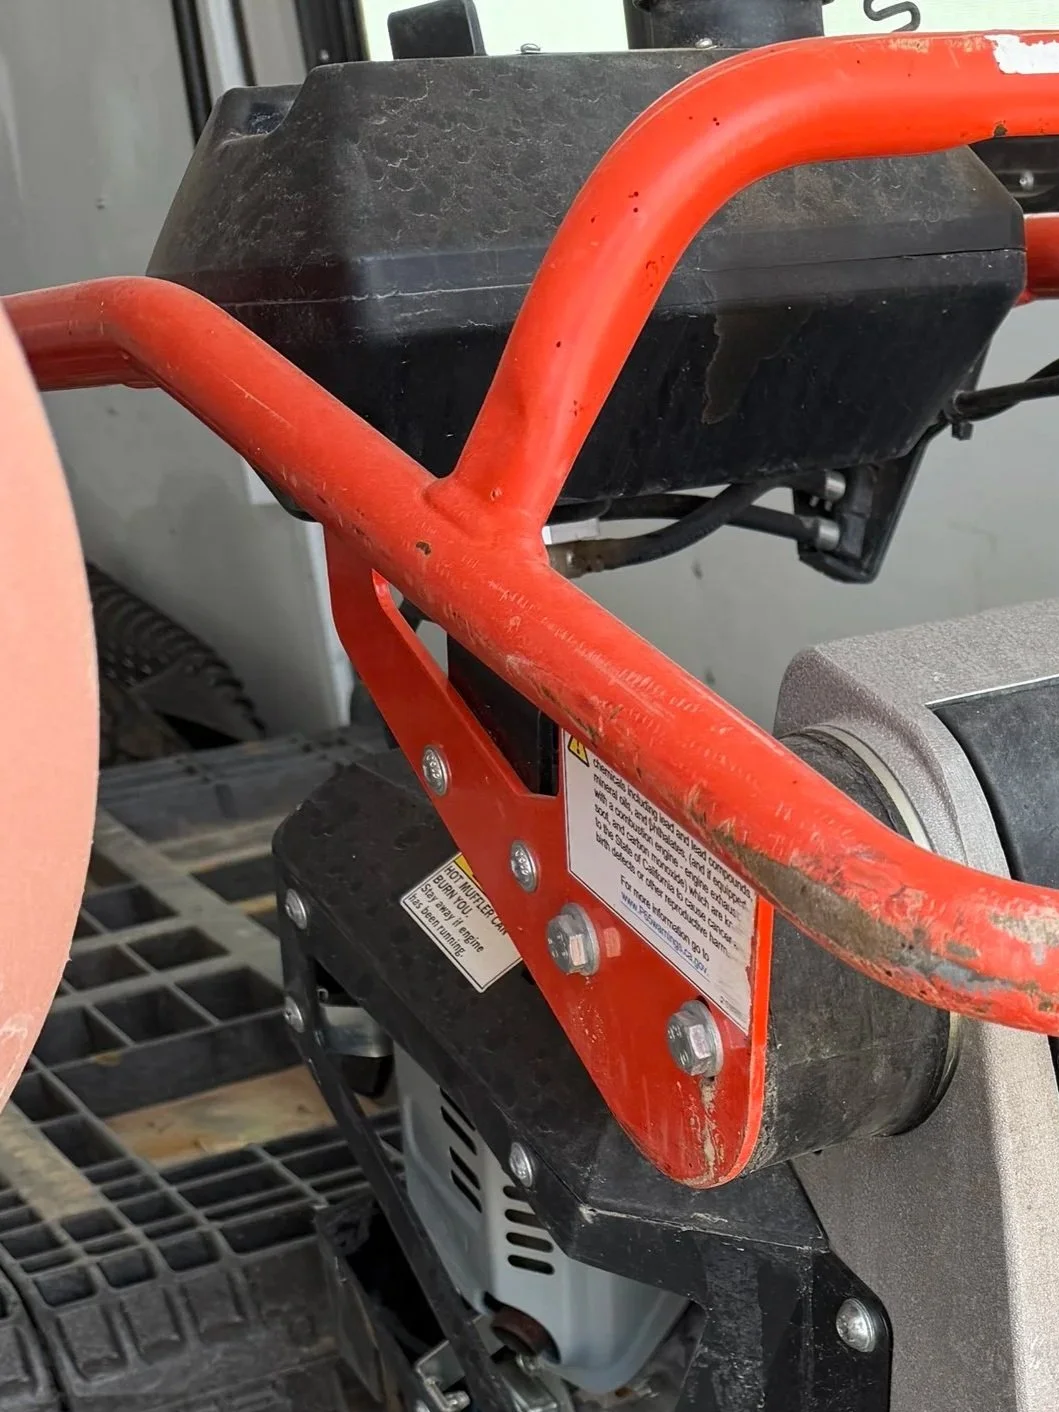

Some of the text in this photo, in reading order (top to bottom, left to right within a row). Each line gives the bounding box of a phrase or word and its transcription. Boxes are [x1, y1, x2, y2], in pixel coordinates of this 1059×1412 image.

[593, 773, 618, 801] mineral
[634, 808, 647, 827] and
[707, 868, 712, 881] if
[594, 788, 608, 807] with
[609, 801, 614, 812] a
[615, 807, 653, 847] combustion
[654, 841, 679, 868] engine
[684, 867, 709, 894] engine
[595, 816, 602, 831] to
[603, 823, 614, 841] the
[615, 834, 633, 858] State
[634, 853, 642, 865] of
[642, 858, 675, 895] California
[676, 887, 684, 902] to
[684, 897, 706, 922] cause
[612, 819, 625, 837] and
[626, 831, 650, 858] carbon
[689, 885, 709, 910] which
[711, 905, 723, 922] are
[659, 812, 674, 835] lead
[676, 829, 689, 848] and
[690, 839, 707, 862] lead
[408, 893, 466, 958] has been running.
[421, 883, 484, 953] Stay away if engine
[433, 874, 473, 918] BURN YOU.
[444, 866, 463, 883] HOT
[460, 881, 494, 918] MUFFLER
[596, 831, 611, 852] birth
[611, 847, 636, 875] defects
[637, 870, 644, 882] or
[645, 877, 664, 899] other
[665, 894, 708, 938] reproductive
[620, 874, 710, 962] For more information go to
